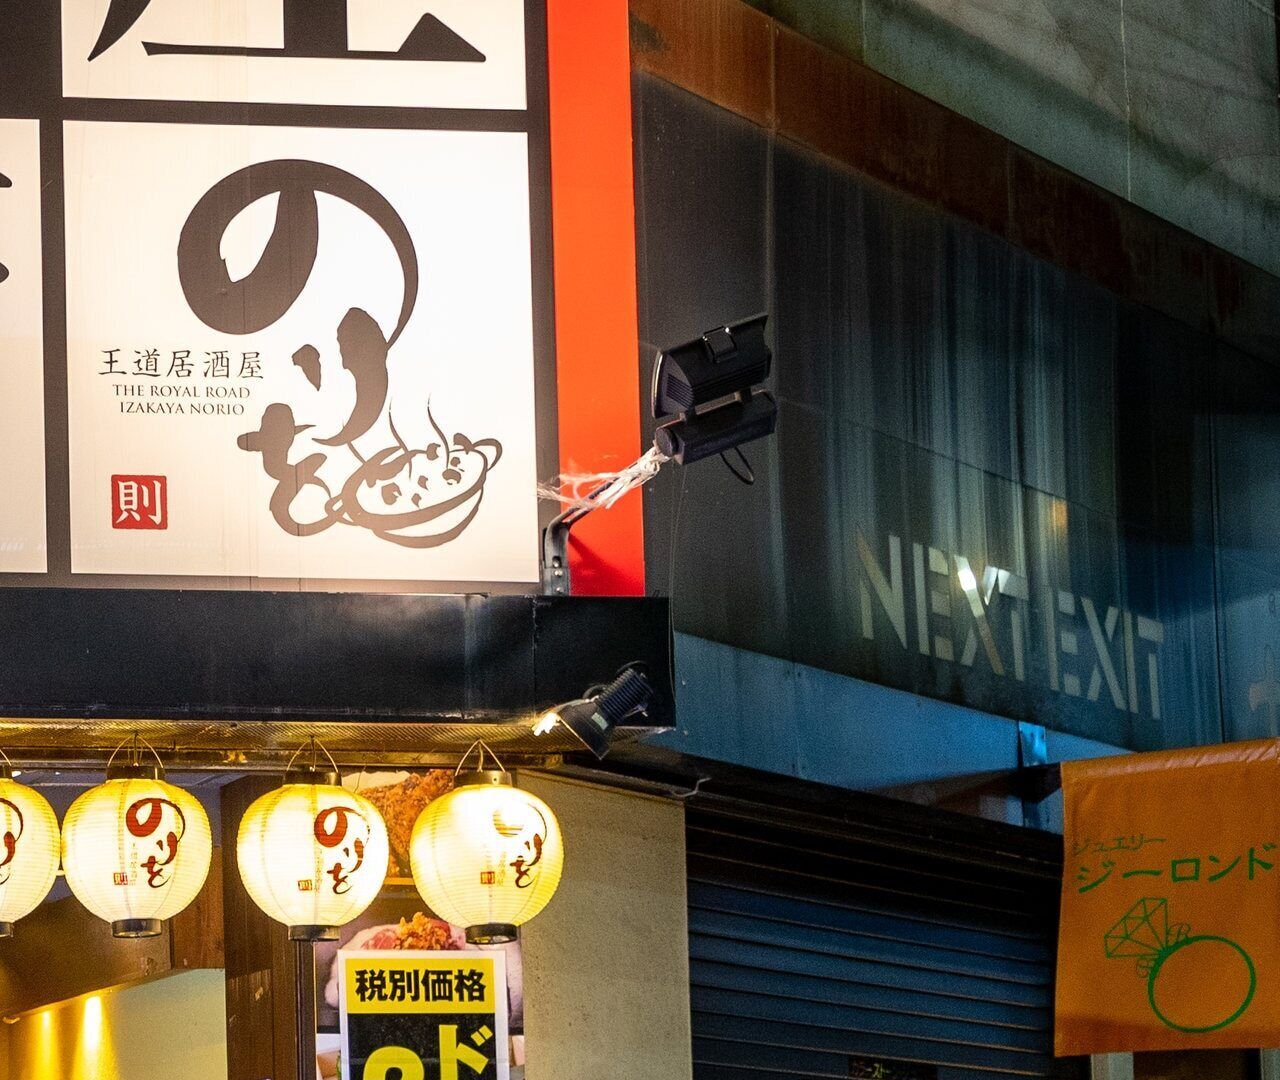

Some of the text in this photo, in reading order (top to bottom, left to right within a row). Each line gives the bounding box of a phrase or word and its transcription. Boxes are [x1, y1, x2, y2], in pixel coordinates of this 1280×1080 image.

[98, 347, 265, 380] 王道居酒屋
[178, 158, 502, 548] のりを
[112, 383, 251, 399] THE ROYAL ROAD
[120, 401, 245, 416] IZAKAYA NORIO
[114, 477, 165, 526] 則
[856, 530, 1164, 722] NEXT EXIT
[126, 796, 187, 889] のりを
[313, 805, 371, 895] のりを
[1075, 842, 1277, 893] ジーロンド
[355, 968, 487, 1003] 税別価格
